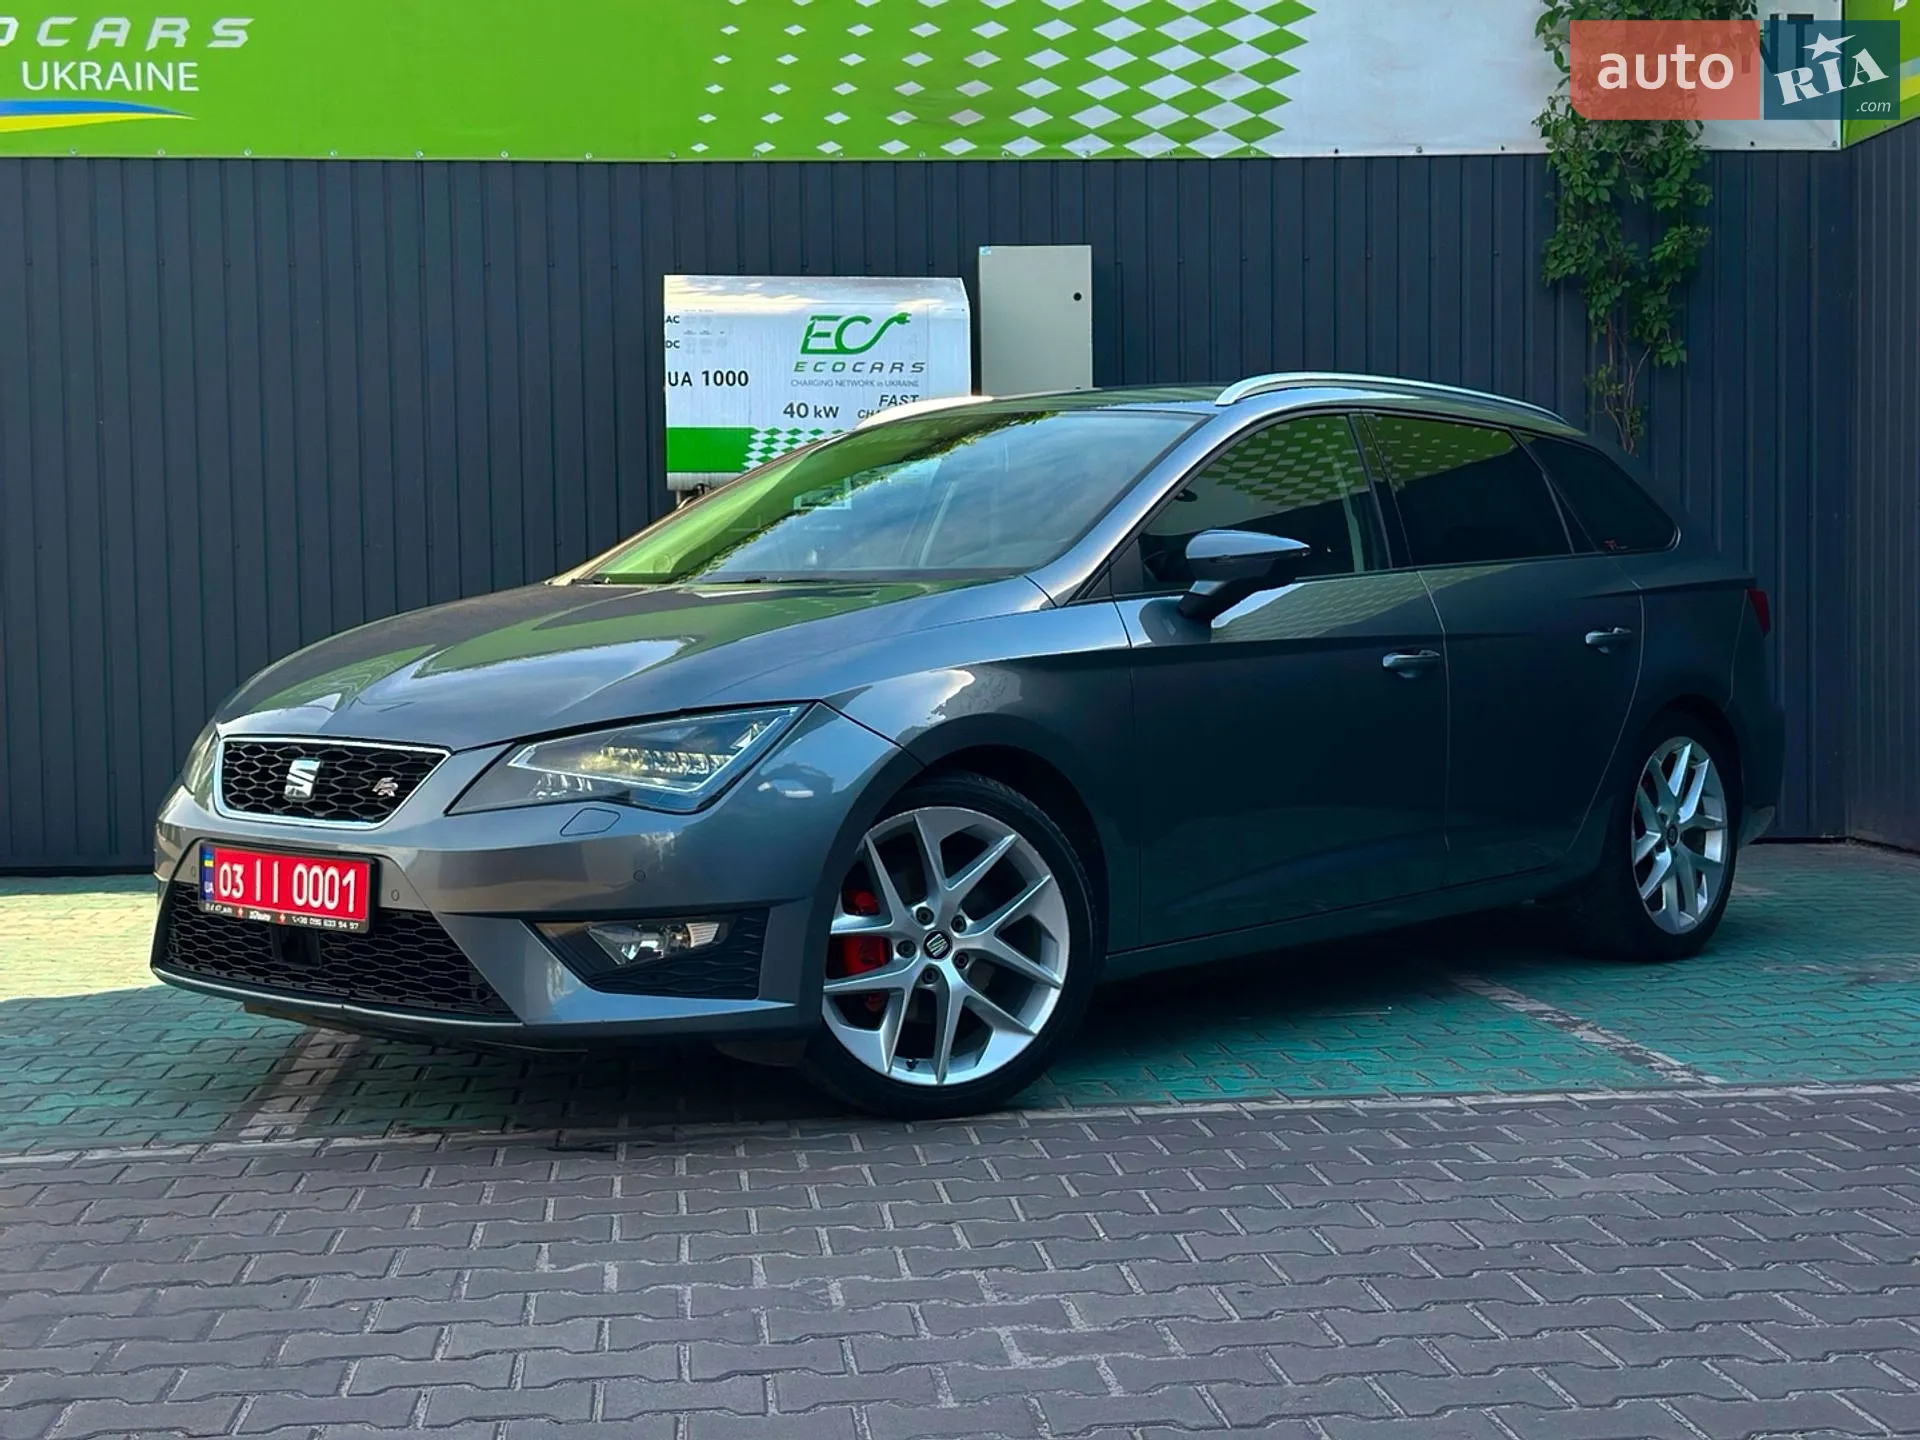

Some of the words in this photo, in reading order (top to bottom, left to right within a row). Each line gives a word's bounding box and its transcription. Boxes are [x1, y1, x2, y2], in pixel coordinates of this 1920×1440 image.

[21, 60, 201, 92] UKRAINE
[664, 315, 681, 324] AC
[664, 339, 681, 349] DC
[793, 361, 926, 375] ECOCARS
[667, 371, 693, 387] UA
[701, 370, 750, 387] 1000
[790, 378, 834, 388] CHARGING
[835, 379, 875, 388] NETWORK
[885, 379, 920, 388] UKRAINE
[878, 394, 920, 408] FAST
[782, 401, 810, 419] 40
[813, 404, 840, 419] kW
[218, 861, 245, 899] 03
[292, 862, 358, 914] 0001
